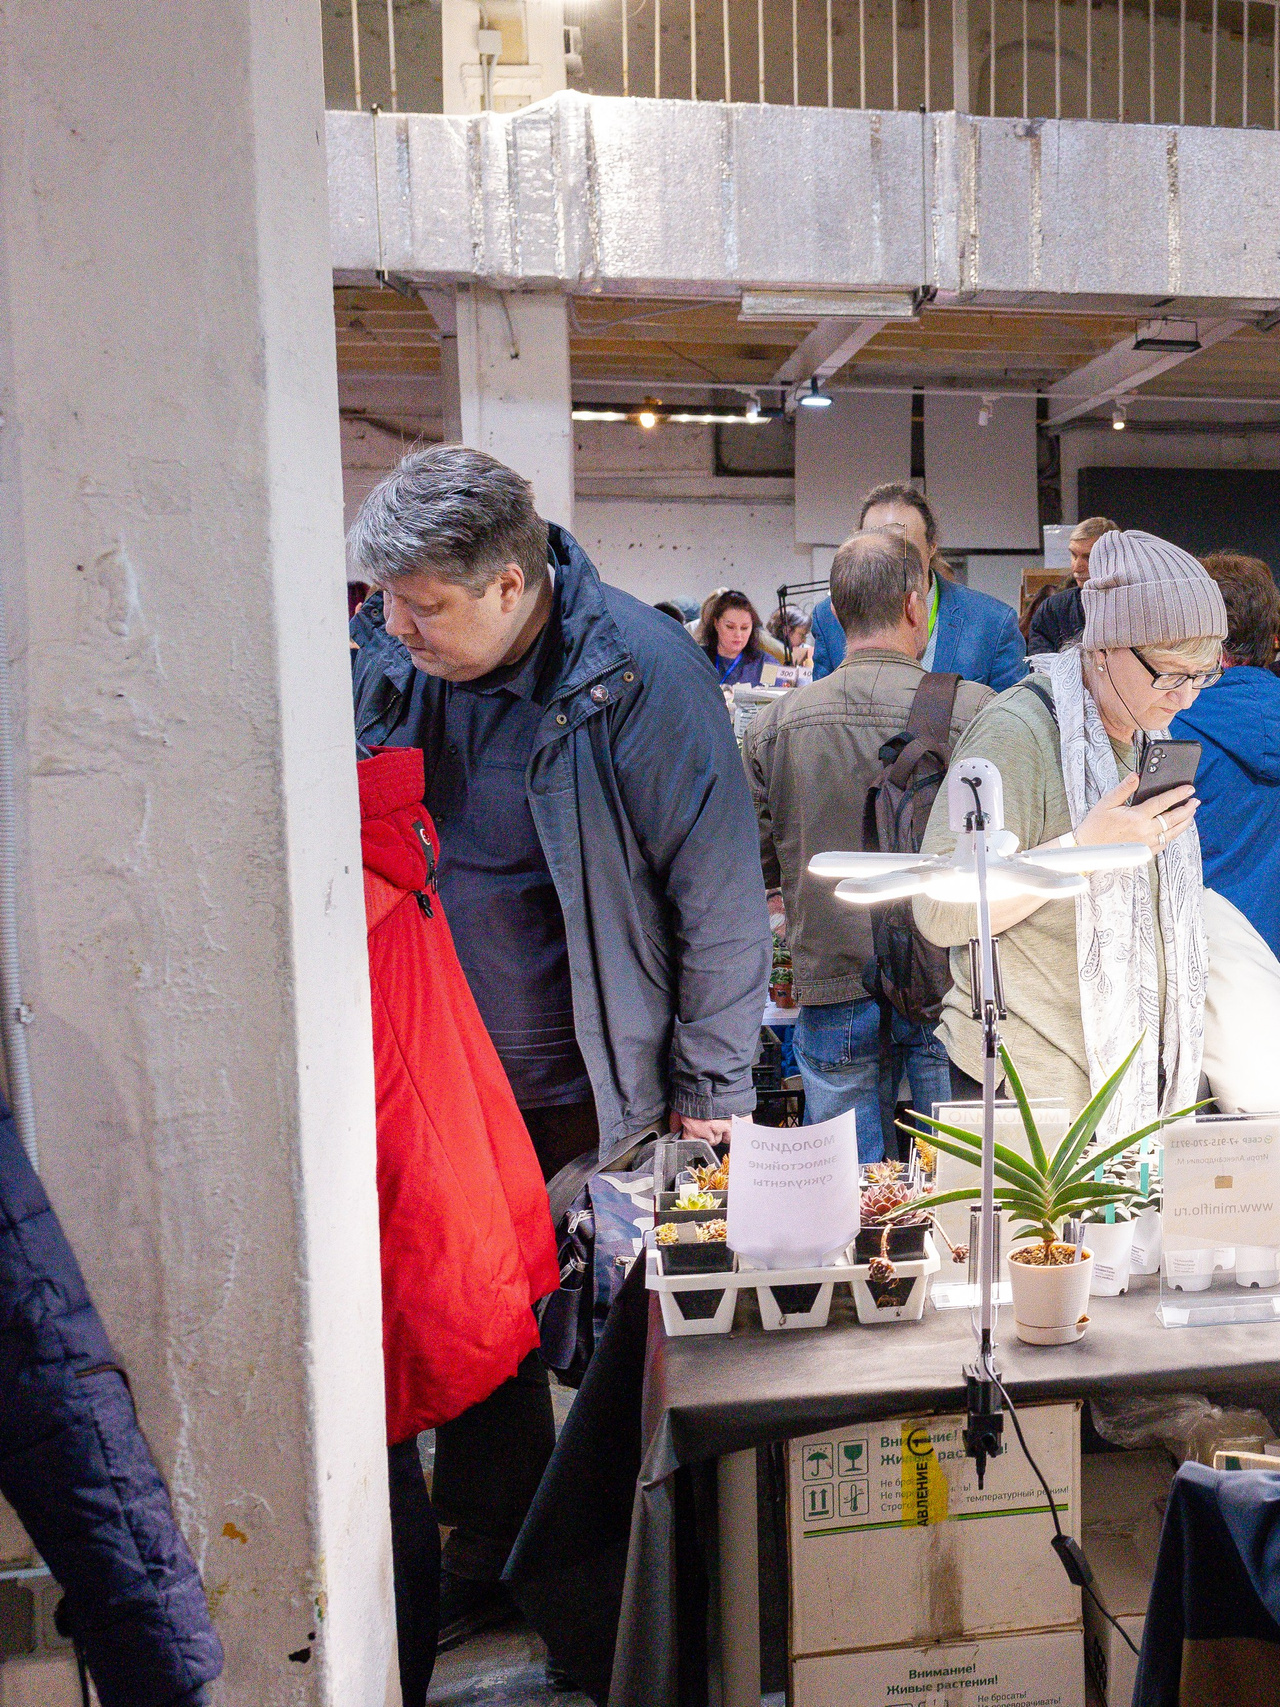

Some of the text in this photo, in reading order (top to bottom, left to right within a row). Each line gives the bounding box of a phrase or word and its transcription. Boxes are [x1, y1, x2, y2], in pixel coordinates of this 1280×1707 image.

[966, 1488, 1035, 1503] температурный
[909, 1663, 976, 1680] Внимание!
[886, 1675, 998, 1696] Живые растения!
[977, 1690, 1027, 1703] Не бросать!
